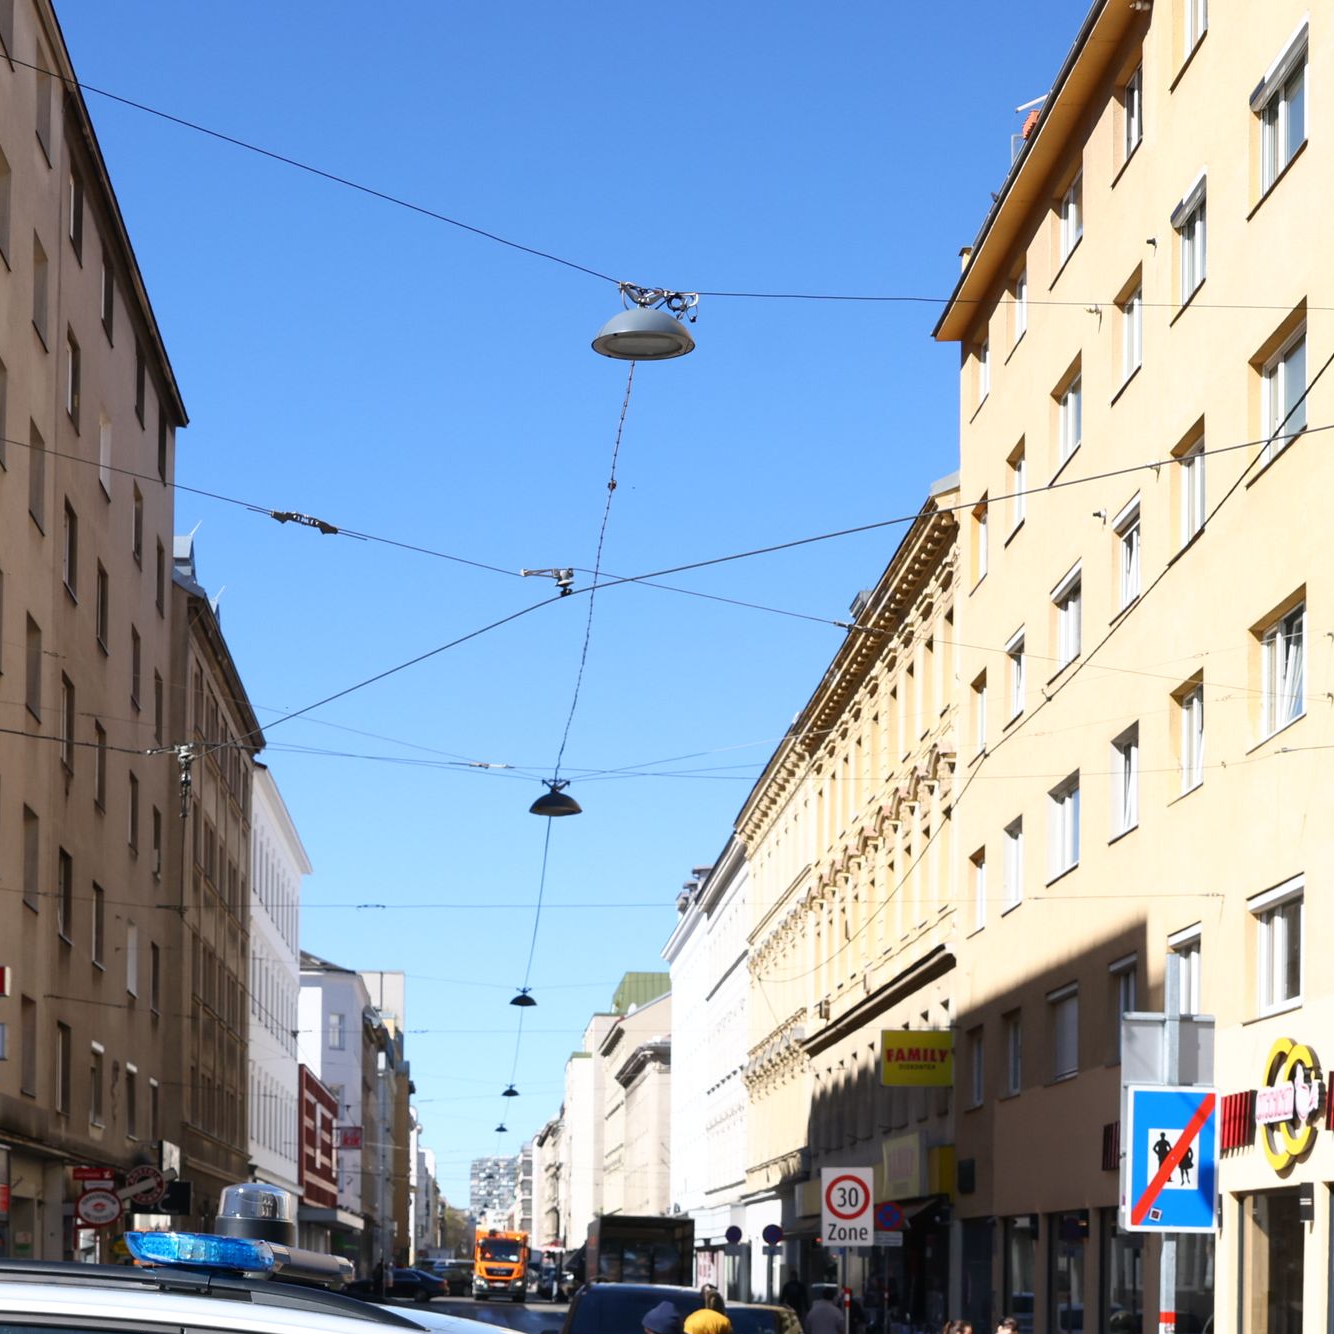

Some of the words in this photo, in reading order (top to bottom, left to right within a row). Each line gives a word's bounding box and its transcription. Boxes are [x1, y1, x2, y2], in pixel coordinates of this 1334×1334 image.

[886, 1047, 948, 1063] FAMILY
[837, 1187, 859, 1208] 30
[828, 1223, 869, 1241] Zone
